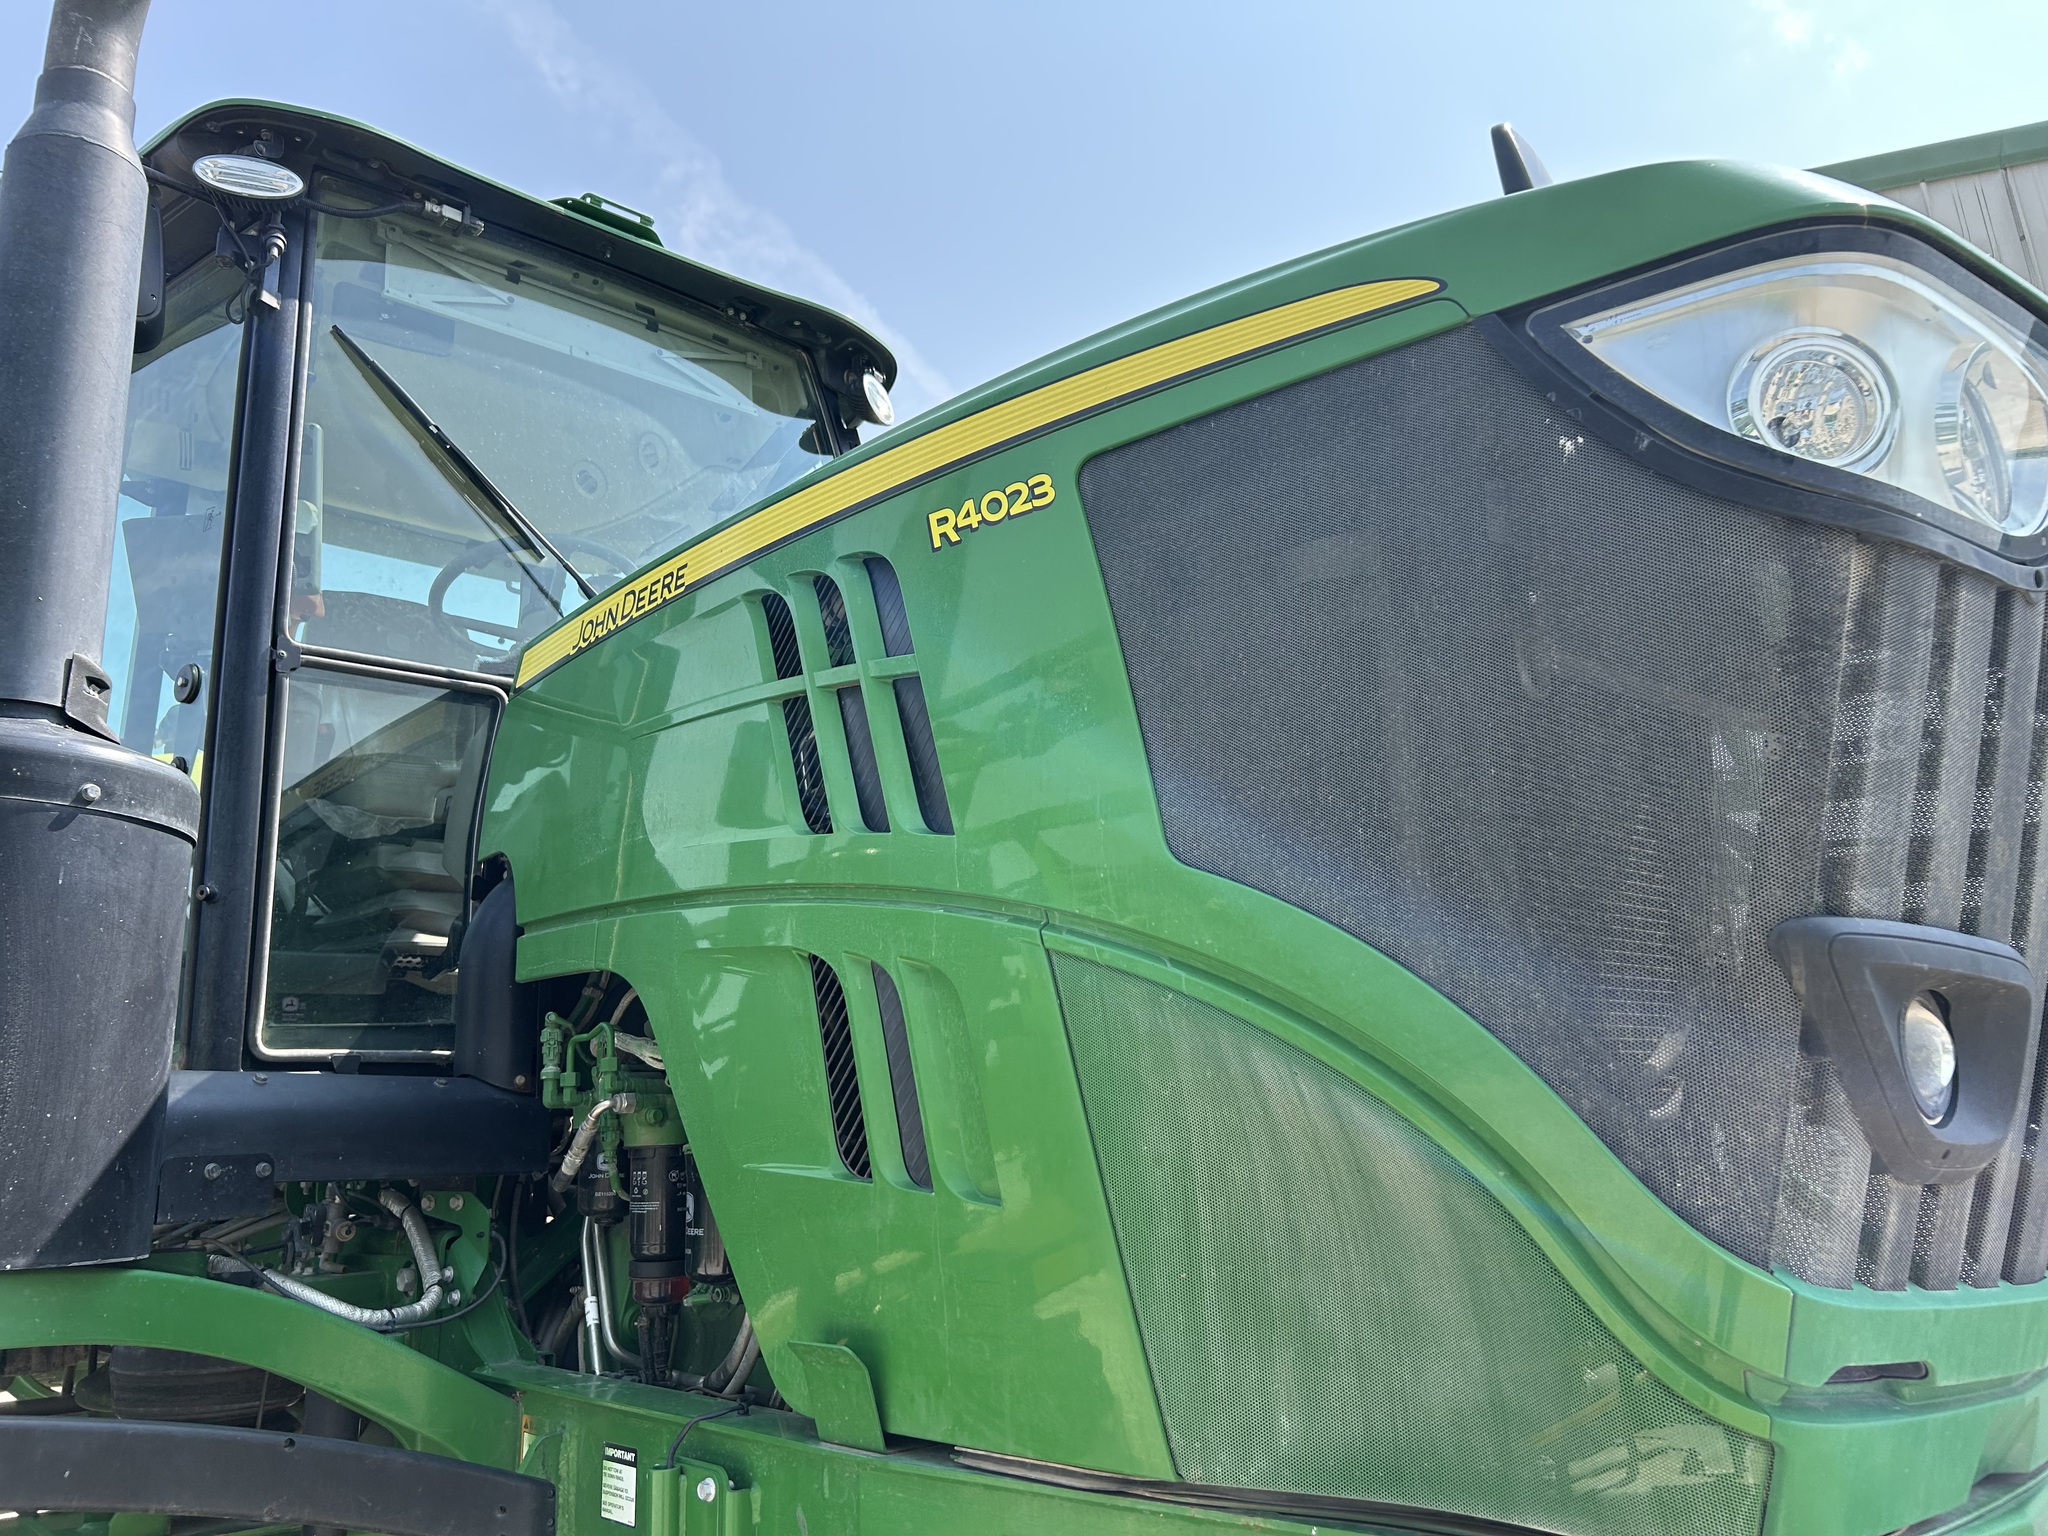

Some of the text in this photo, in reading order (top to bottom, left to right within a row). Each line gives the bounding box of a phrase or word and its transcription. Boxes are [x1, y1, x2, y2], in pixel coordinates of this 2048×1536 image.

[927, 473, 1056, 552] R4023
[571, 562, 689, 652] JOHN DEERE
[604, 1446, 636, 1462] IMPORTANT
